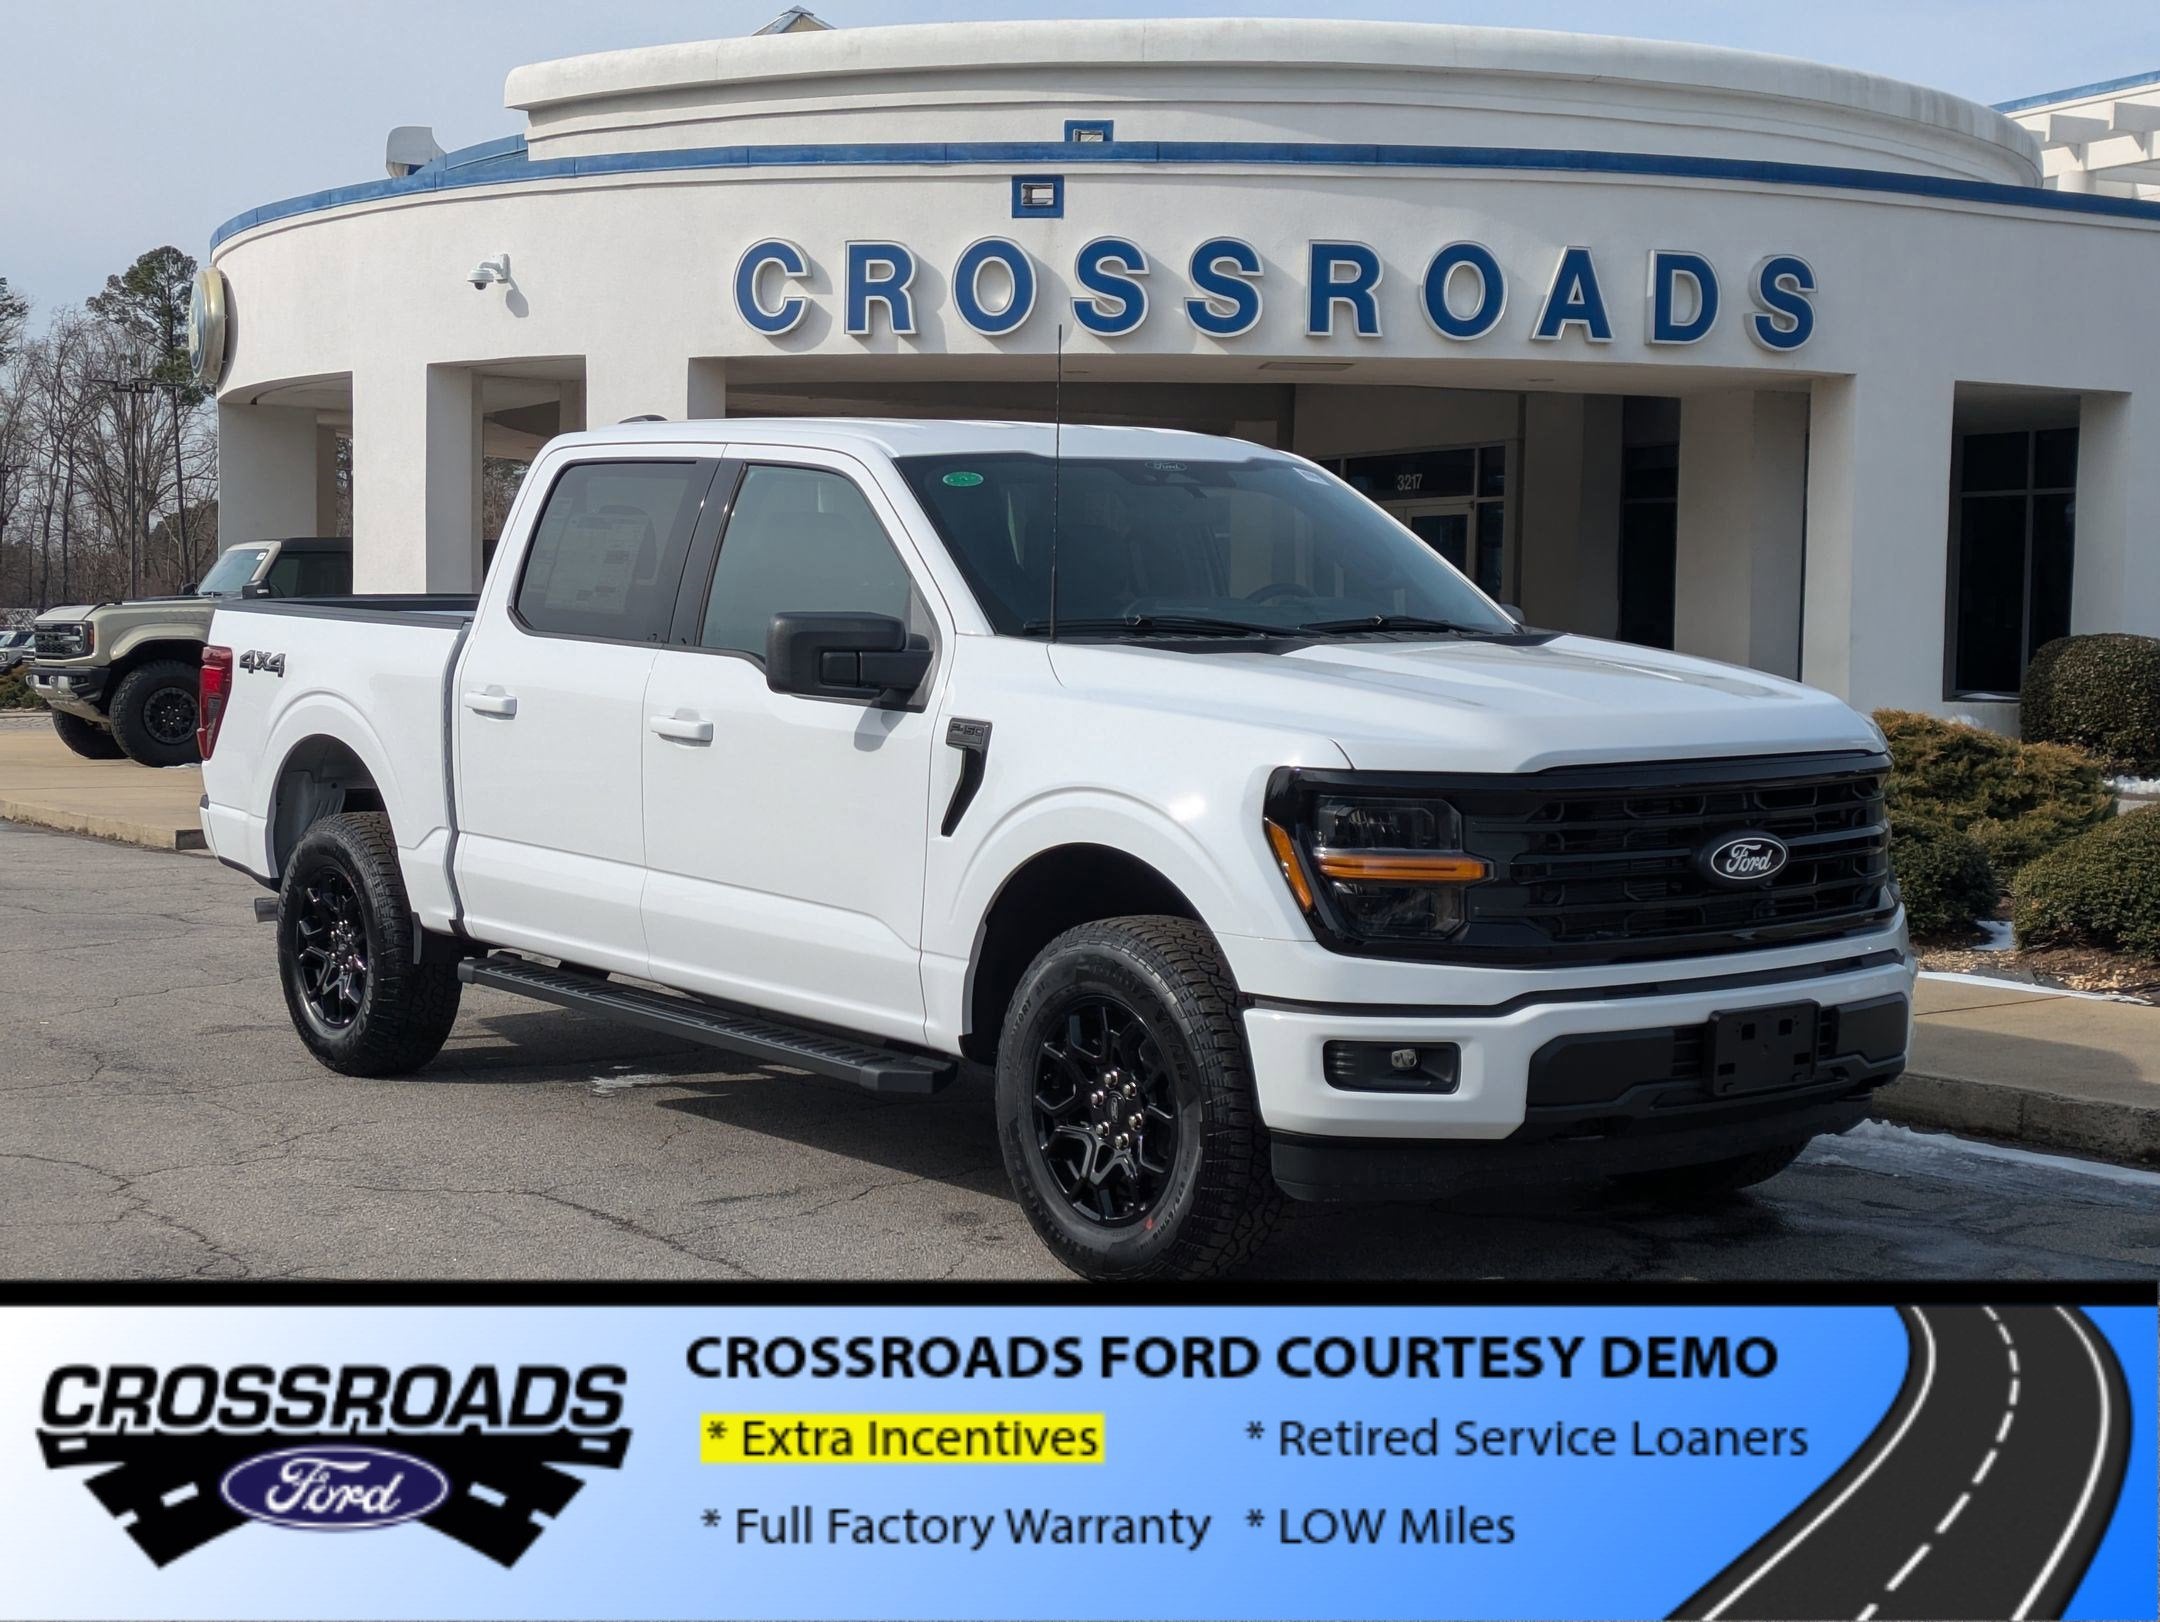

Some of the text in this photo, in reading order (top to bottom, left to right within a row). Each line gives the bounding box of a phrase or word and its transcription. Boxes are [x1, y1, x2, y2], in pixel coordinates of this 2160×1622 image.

[733, 235, 1818, 352] CROSSROADS
[1397, 473, 1422, 490] 3217
[1726, 843, 1773, 873] Ford
